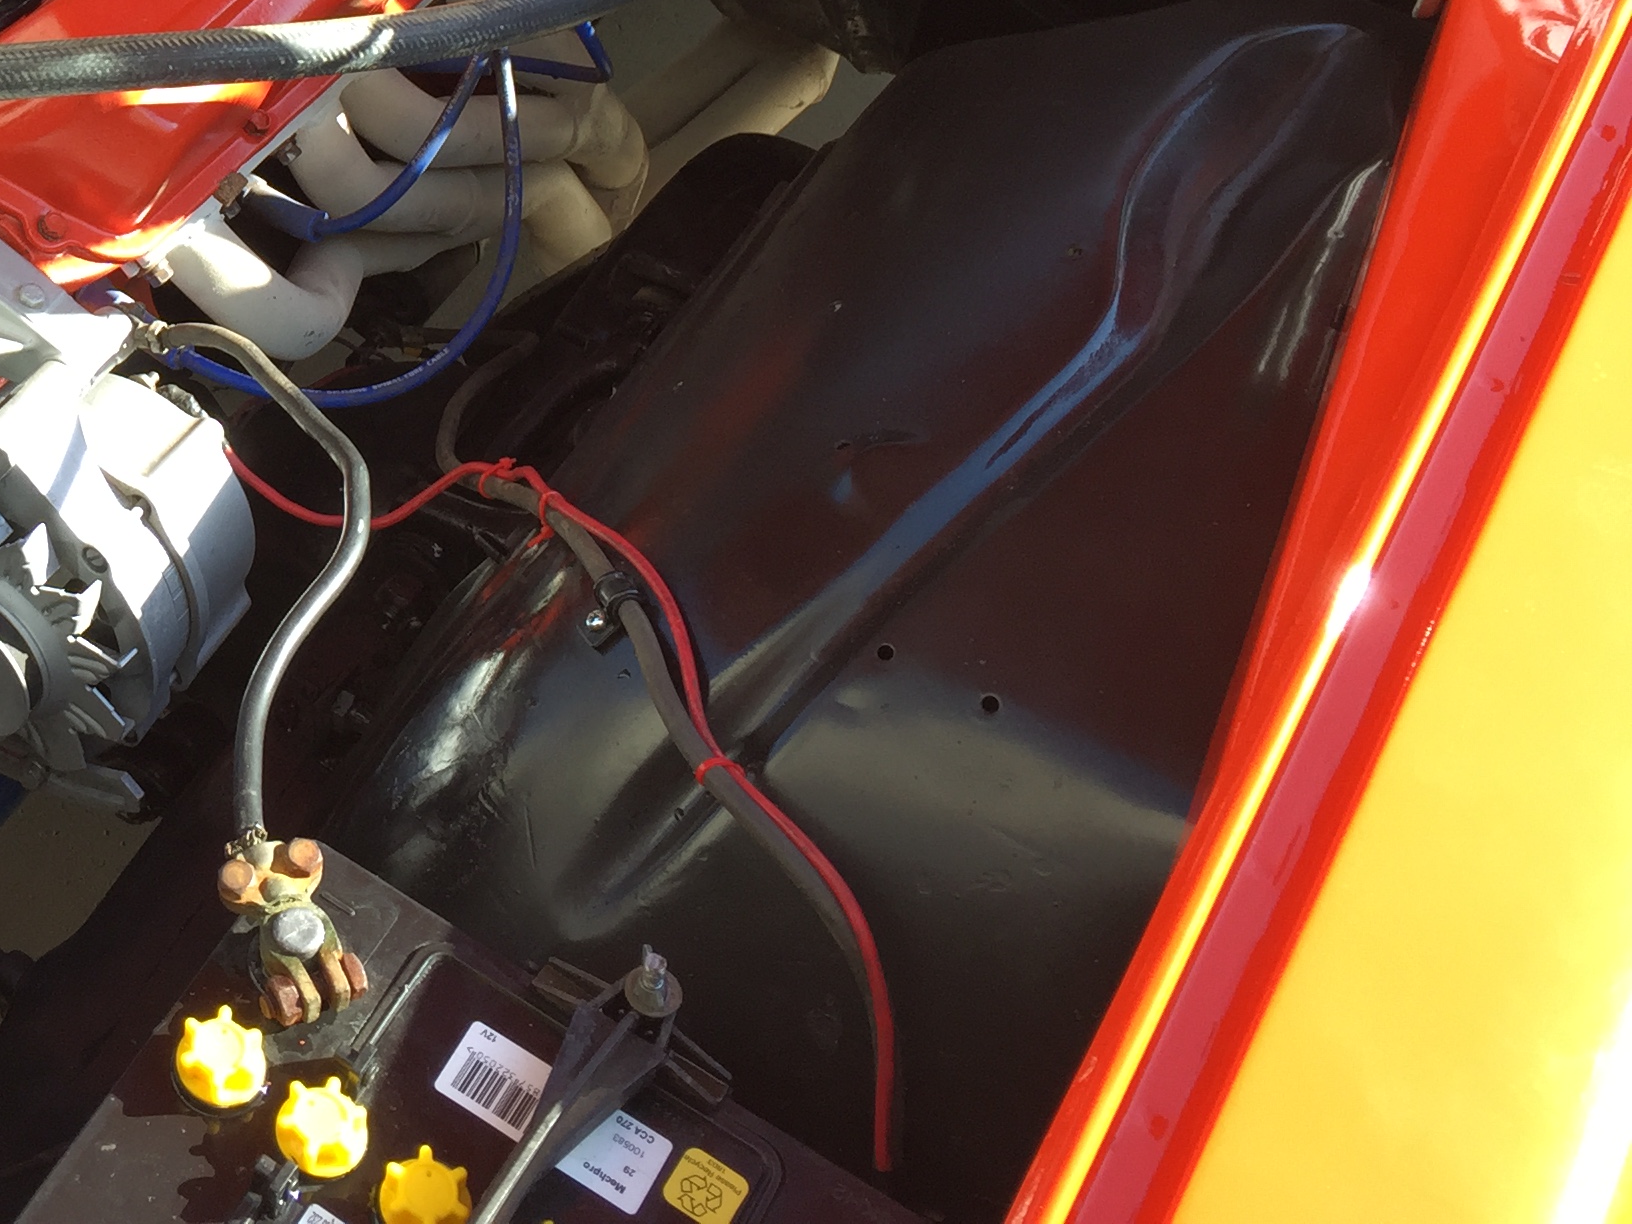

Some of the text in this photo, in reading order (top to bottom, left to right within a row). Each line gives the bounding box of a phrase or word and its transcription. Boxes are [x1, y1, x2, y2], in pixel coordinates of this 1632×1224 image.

[479, 1028, 498, 1043] 12V
[615, 1115, 656, 1145] CCA 270
[612, 1133, 646, 1159] 100583
[582, 1160, 627, 1195] Mechpro
[622, 1164, 636, 1178] 29
[683, 1153, 743, 1197] Please Recycle
